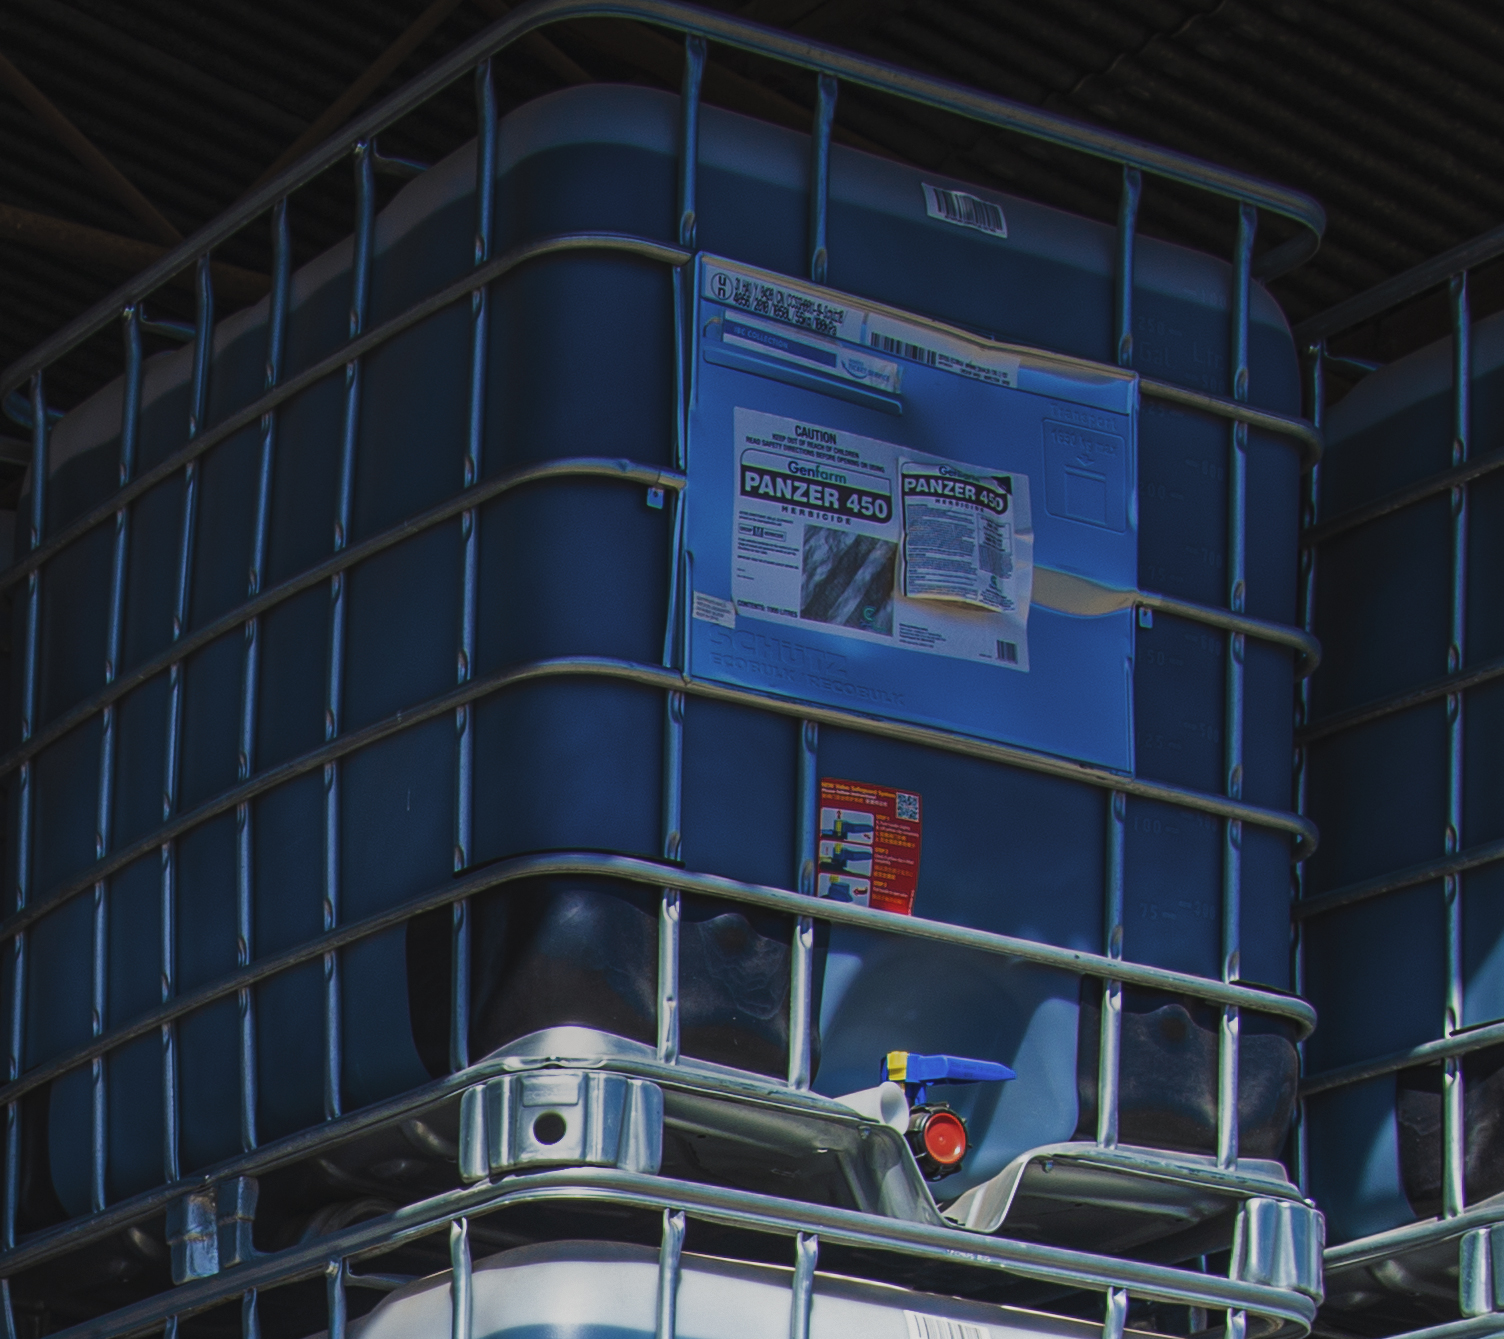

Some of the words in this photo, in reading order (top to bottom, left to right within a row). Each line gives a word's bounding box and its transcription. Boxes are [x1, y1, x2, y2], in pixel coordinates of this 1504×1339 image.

[795, 424, 836, 445] CAUTION
[788, 460, 846, 484] Genfarm
[744, 471, 840, 509] PANZER
[846, 494, 888, 519] 450
[904, 478, 975, 501] PANZER
[781, 505, 851, 525] HERBICIDE
